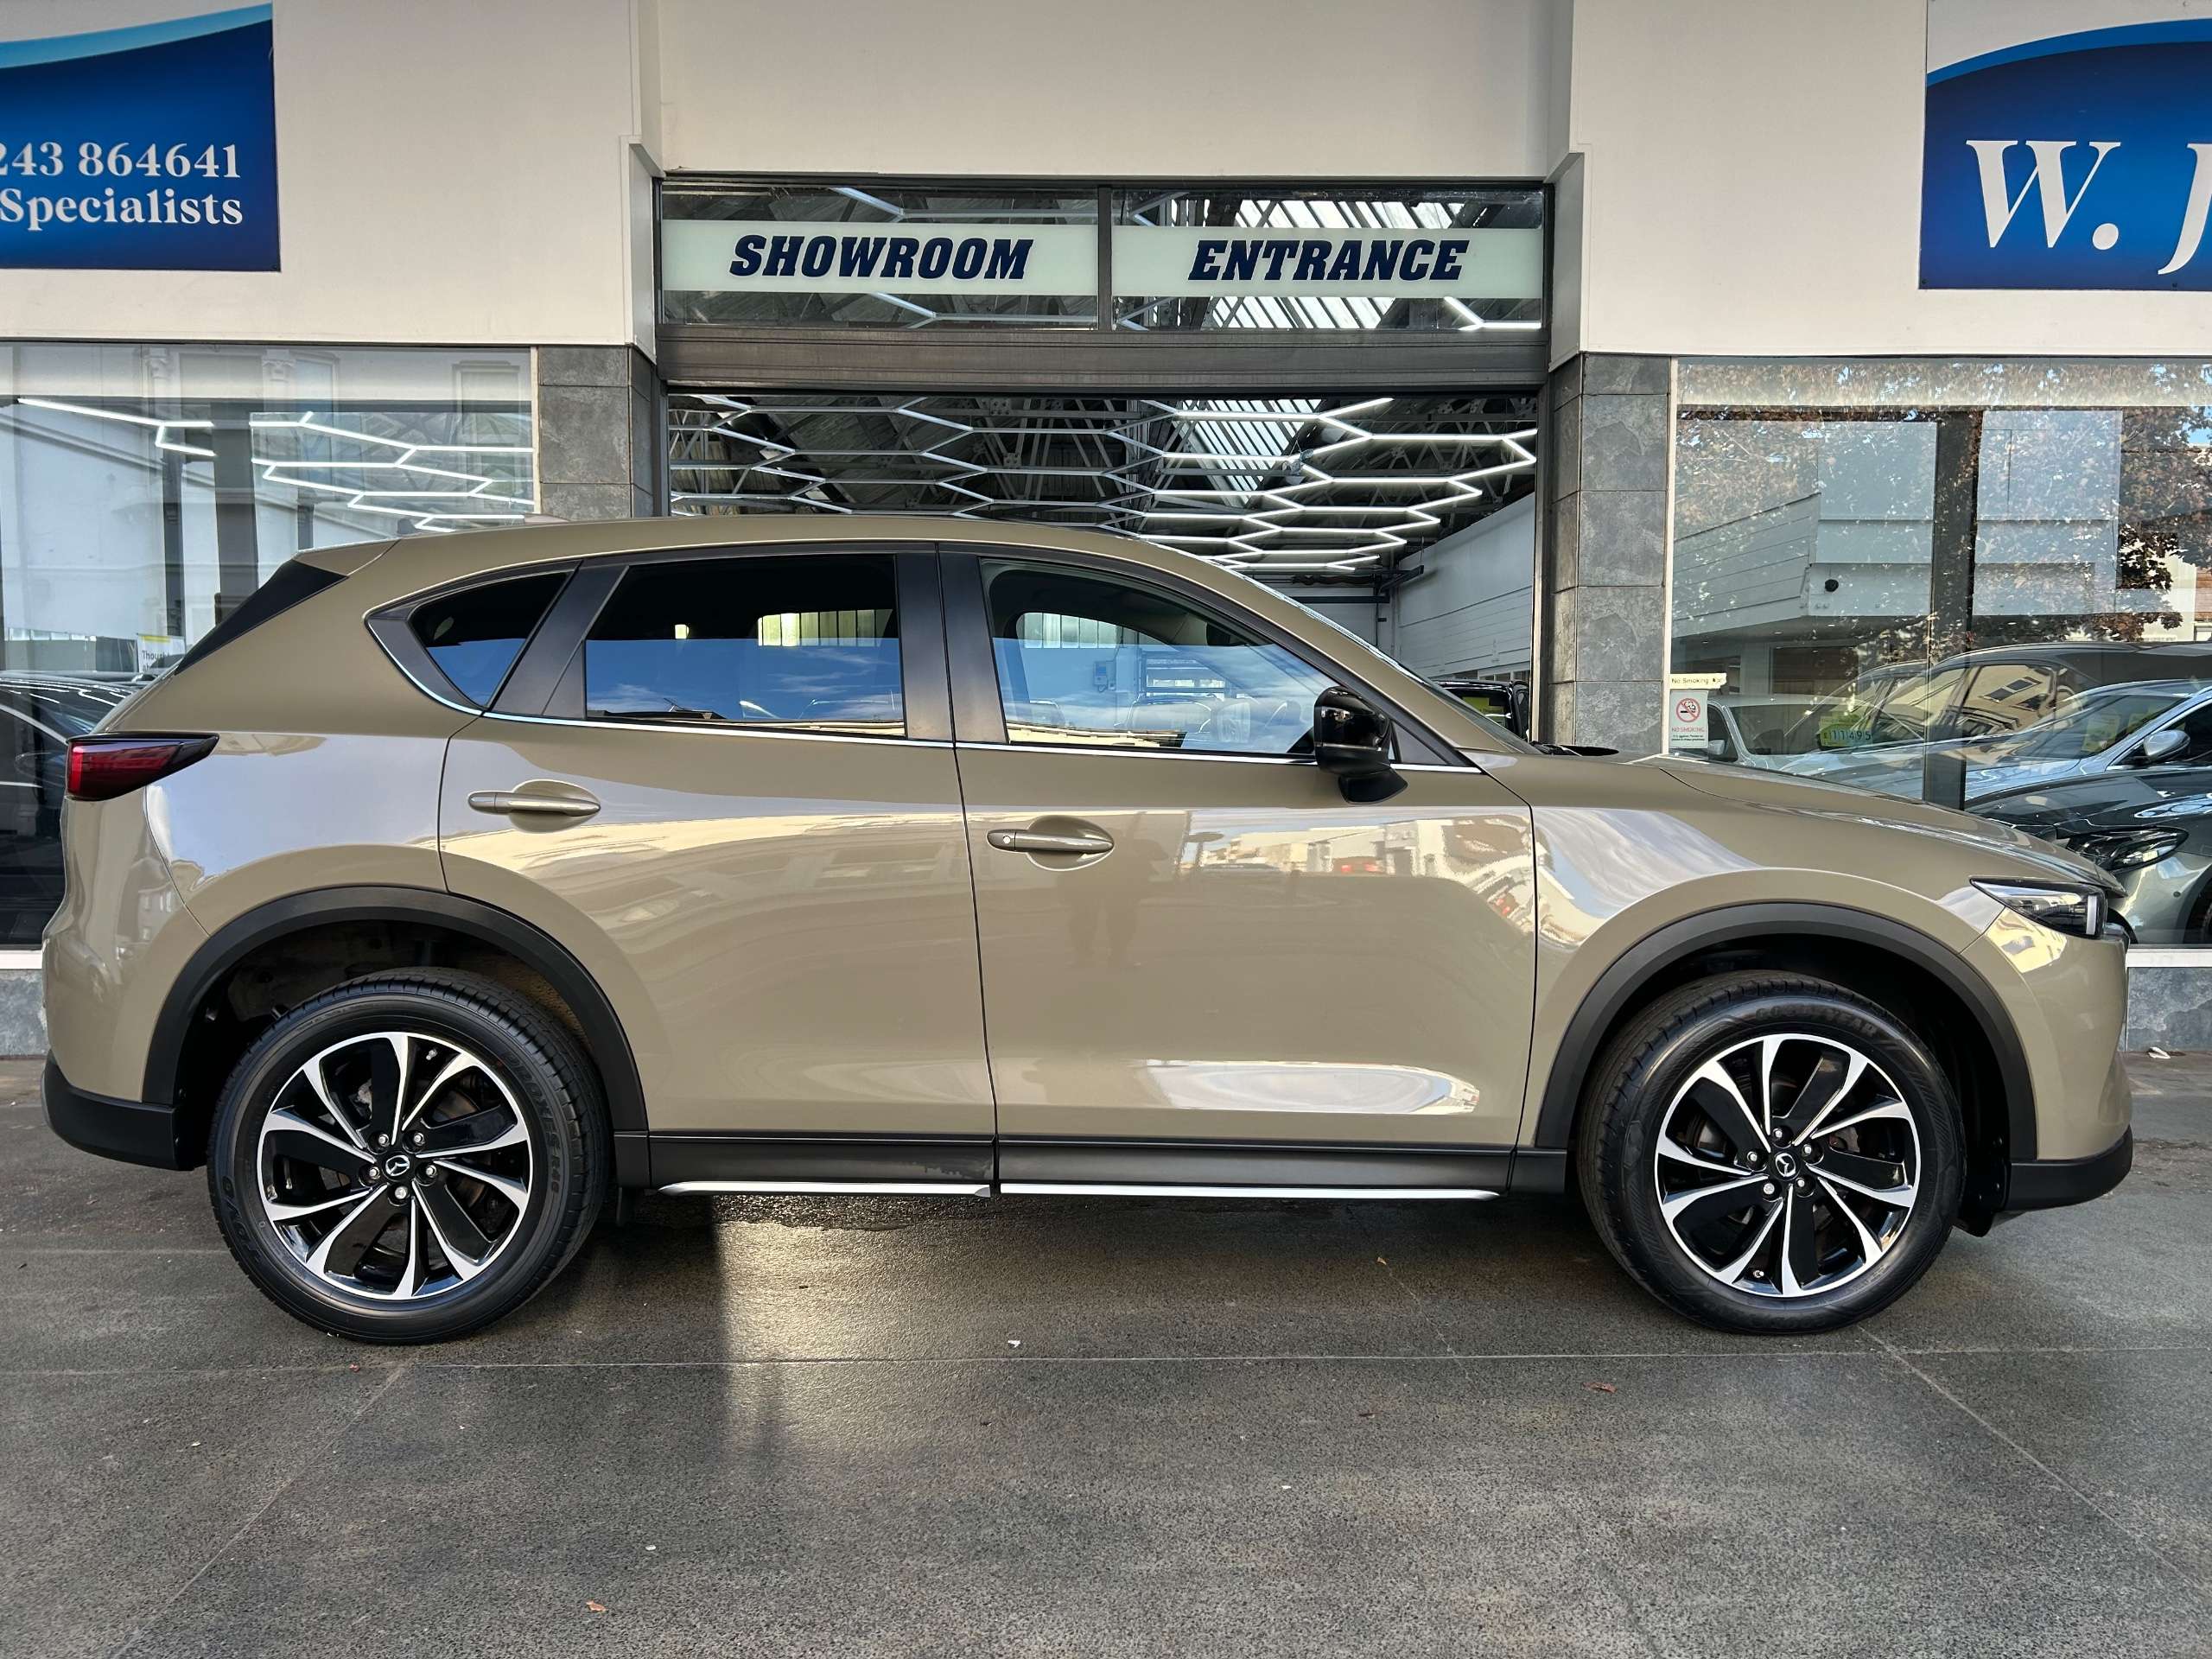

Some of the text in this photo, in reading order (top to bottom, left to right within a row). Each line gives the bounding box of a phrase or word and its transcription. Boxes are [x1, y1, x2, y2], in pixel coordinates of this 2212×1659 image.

[78, 142, 241, 178] 864641
[0, 187, 243, 232] Specialists
[1966, 140, 2121, 251] W.
[729, 234, 1033, 280] SHOWROOM
[1187, 238, 1470, 281] ENTRANCE
